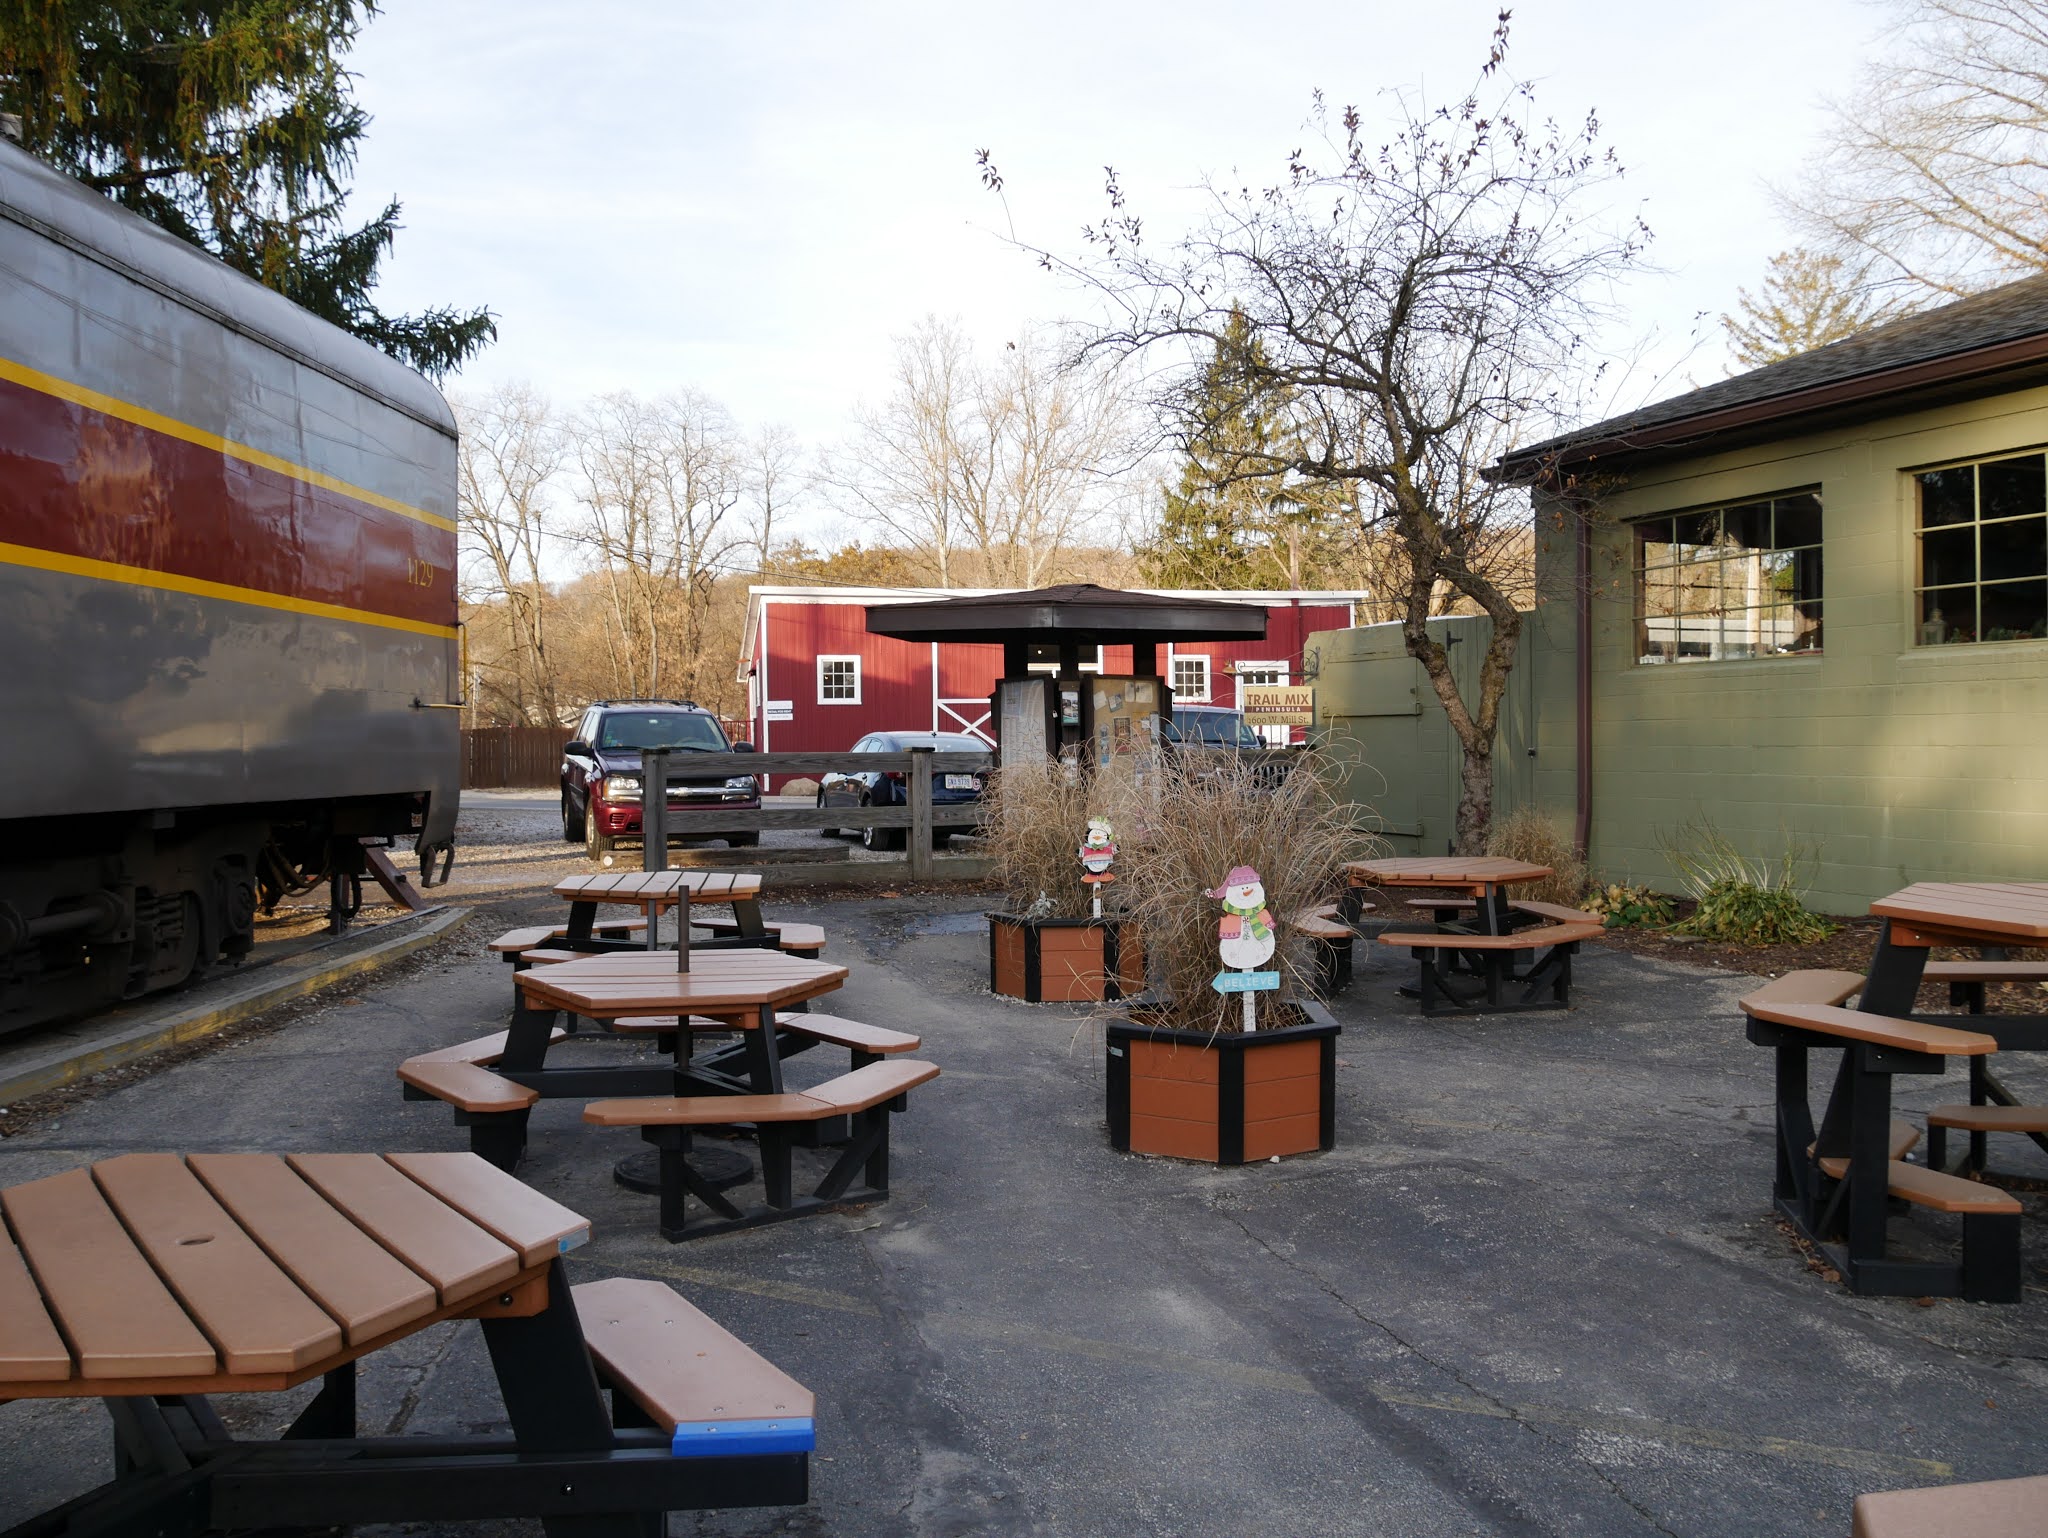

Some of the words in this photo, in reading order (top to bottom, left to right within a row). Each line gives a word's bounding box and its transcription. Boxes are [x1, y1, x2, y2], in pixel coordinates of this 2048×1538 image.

[407, 557, 433, 587] 1129
[1246, 693, 1280, 705] TRAIL
[1285, 693, 1309, 705] MIX
[1248, 715, 1267, 724] 1600
[1280, 715, 1297, 724] Mill
[1298, 715, 1309, 724] St.
[1224, 976, 1274, 987] BELIEVE
